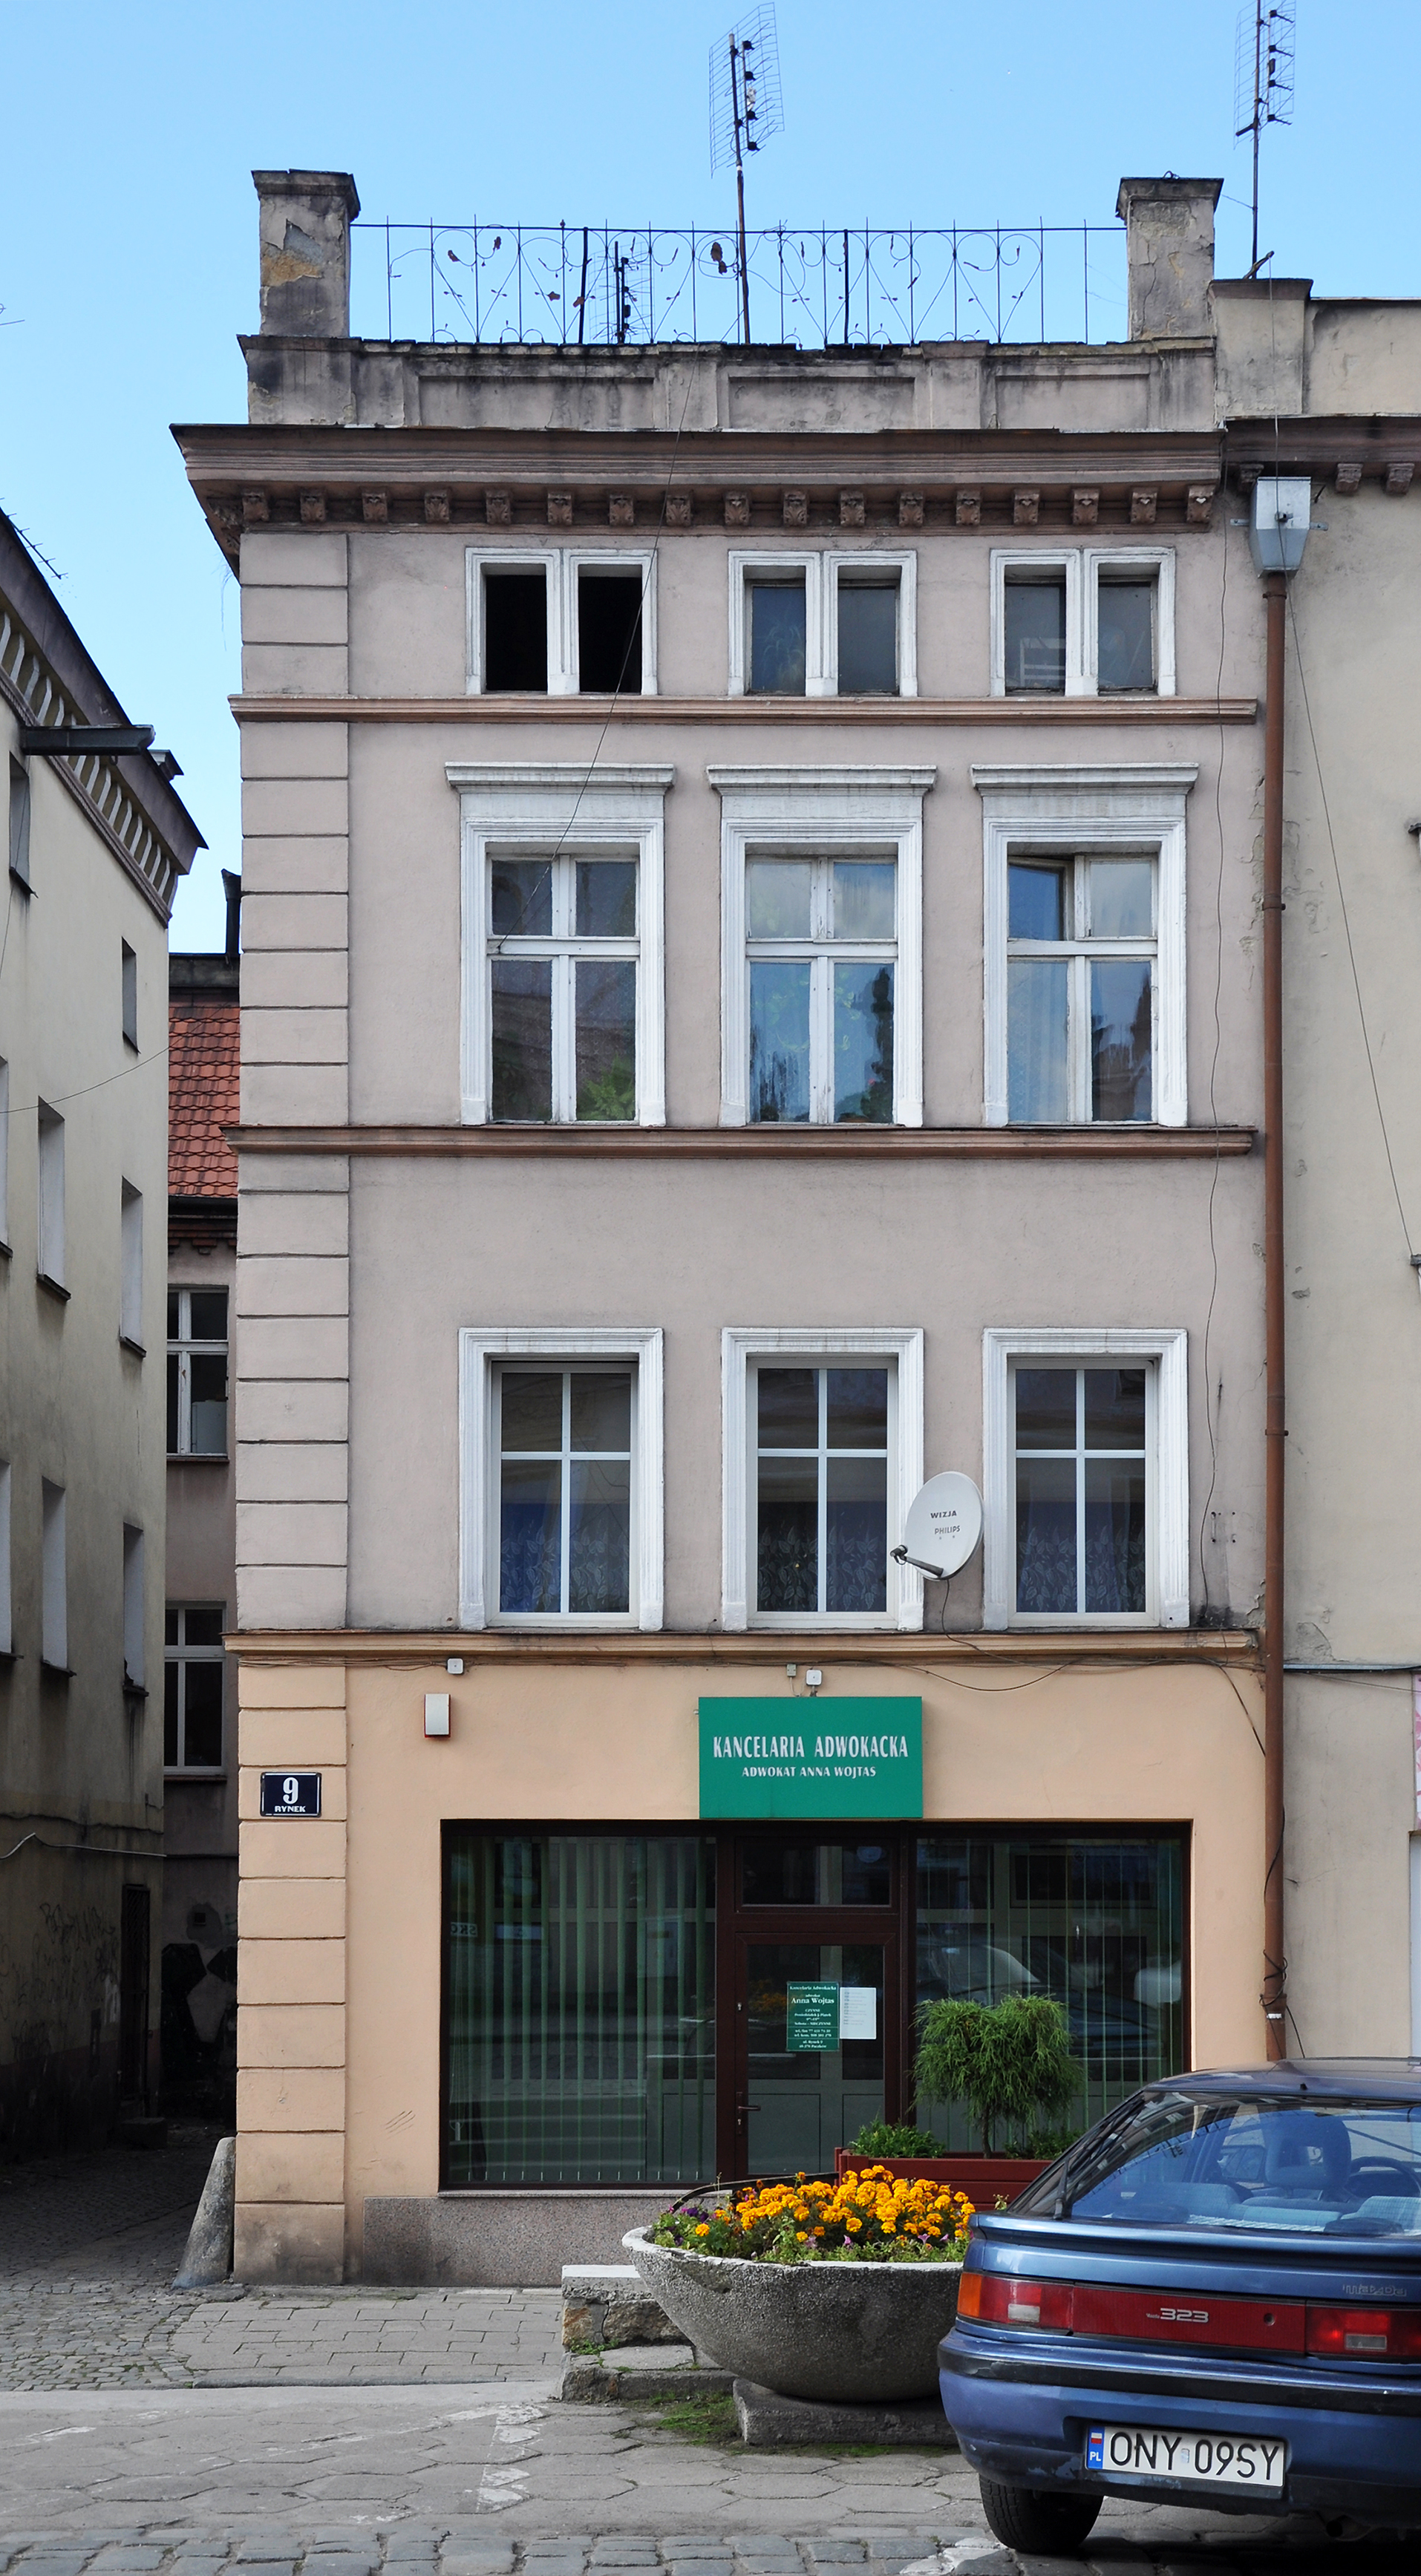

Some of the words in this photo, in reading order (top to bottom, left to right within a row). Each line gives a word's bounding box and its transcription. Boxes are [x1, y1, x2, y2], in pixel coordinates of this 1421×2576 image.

[930, 1510, 957, 1519] WIZJA
[934, 1525, 961, 1534] PHILIPS
[713, 1736, 805, 1758] KANCELARIA
[814, 1736, 909, 1758] ADWOKACKA
[742, 1766, 796, 1777] ADWOKAT
[800, 1766, 831, 1777] ANNA
[834, 1766, 876, 1779] WOJTAS
[283, 1776, 299, 1805] 9
[811, 1997, 834, 2005] Wojtas
[1160, 2307, 1209, 2323] 323
[1089, 2451, 1102, 2462] PL
[1110, 2431, 1183, 2471] ONY
[1195, 2439, 1281, 2481] 09SY
